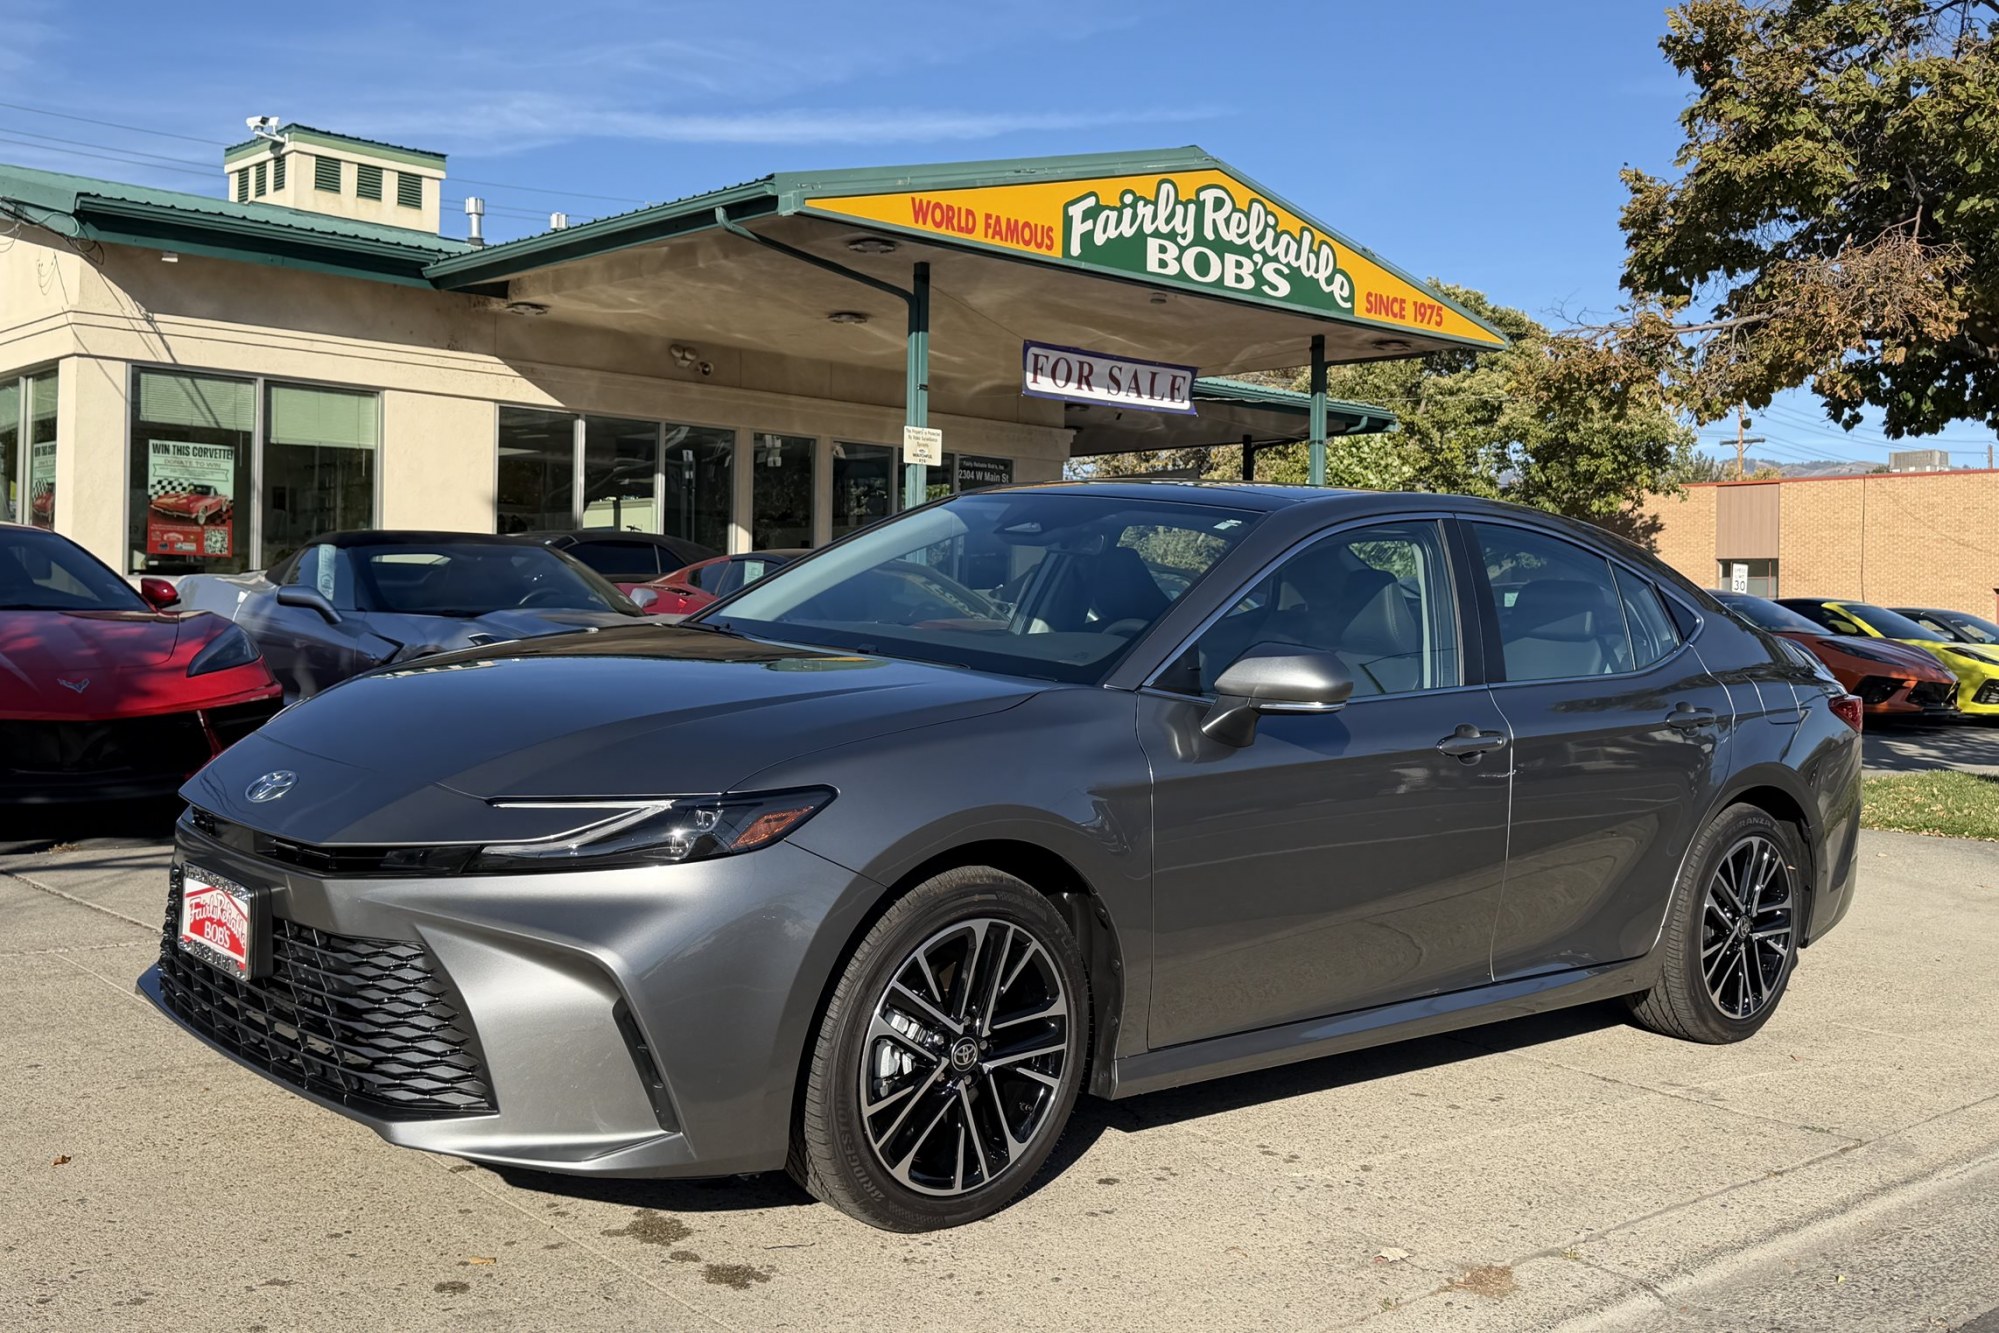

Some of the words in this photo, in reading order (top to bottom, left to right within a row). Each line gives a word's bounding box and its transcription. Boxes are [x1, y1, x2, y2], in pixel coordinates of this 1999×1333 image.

[910, 196, 977, 235] WORLD
[984, 212, 1054, 251] FAMOUS
[1068, 182, 1196, 257] Fairly
[1199, 187, 1352, 308] Reliable
[1146, 236, 1291, 298] BOB'S
[1365, 291, 1406, 320] SINCE
[1413, 301, 1443, 327] 1975
[1030, 353, 1094, 392] FOR
[1107, 364, 1186, 404] SALE
[152, 442, 170, 455] WIN
[172, 445, 190, 457] THIS
[192, 446, 234, 460] CORVETTE!
[164, 459, 192, 467] DONATE
[958, 469, 975, 480] 2304
[975, 471, 983, 480] W
[984, 471, 1000, 482] Main
[1001, 473, 1009, 483] St
[1734, 580, 1746, 591] 30
[189, 895, 218, 923] Fairly
[204, 920, 231, 949] BOB'S
